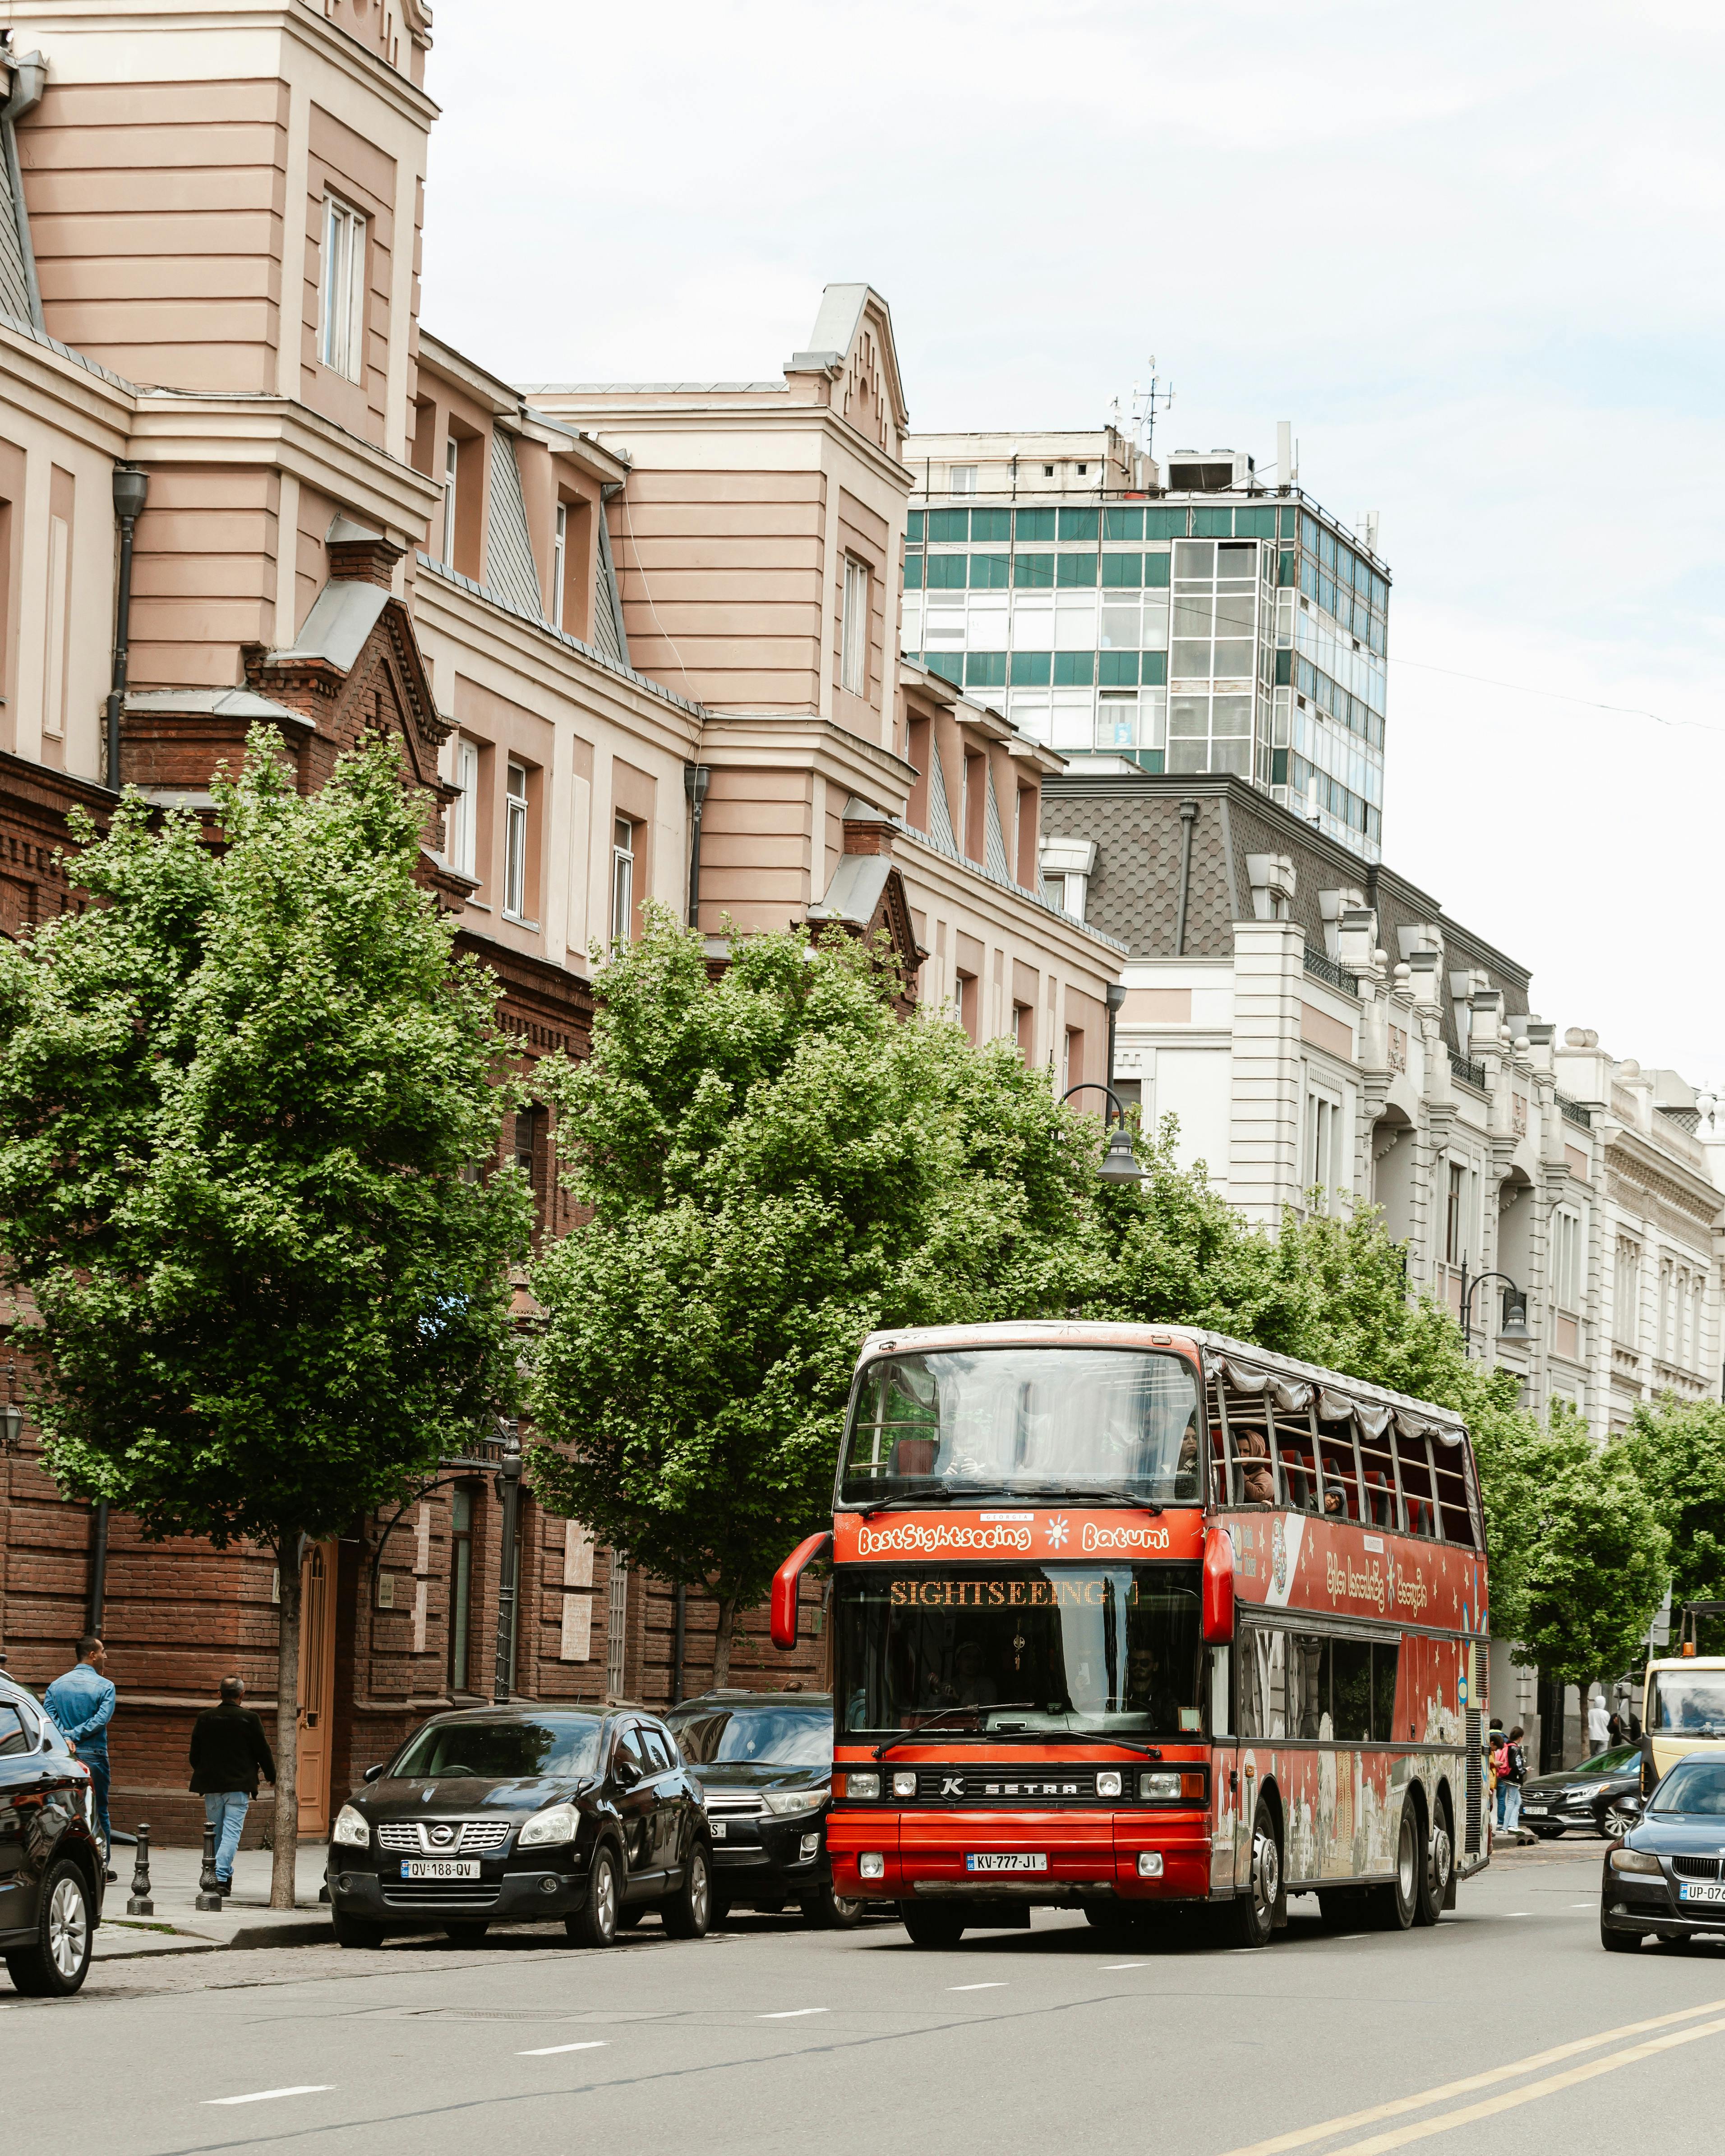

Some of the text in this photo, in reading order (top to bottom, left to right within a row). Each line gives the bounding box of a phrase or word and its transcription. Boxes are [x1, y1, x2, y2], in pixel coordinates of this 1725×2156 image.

[1082, 1522, 1170, 1551] Batumi
[890, 1580, 1108, 1605] SIGHTSEEING
[985, 1785, 1077, 1794] SETRA
[977, 1856, 1036, 1868] KV-777-JI
[412, 1863, 470, 1876] QV-188-QV
